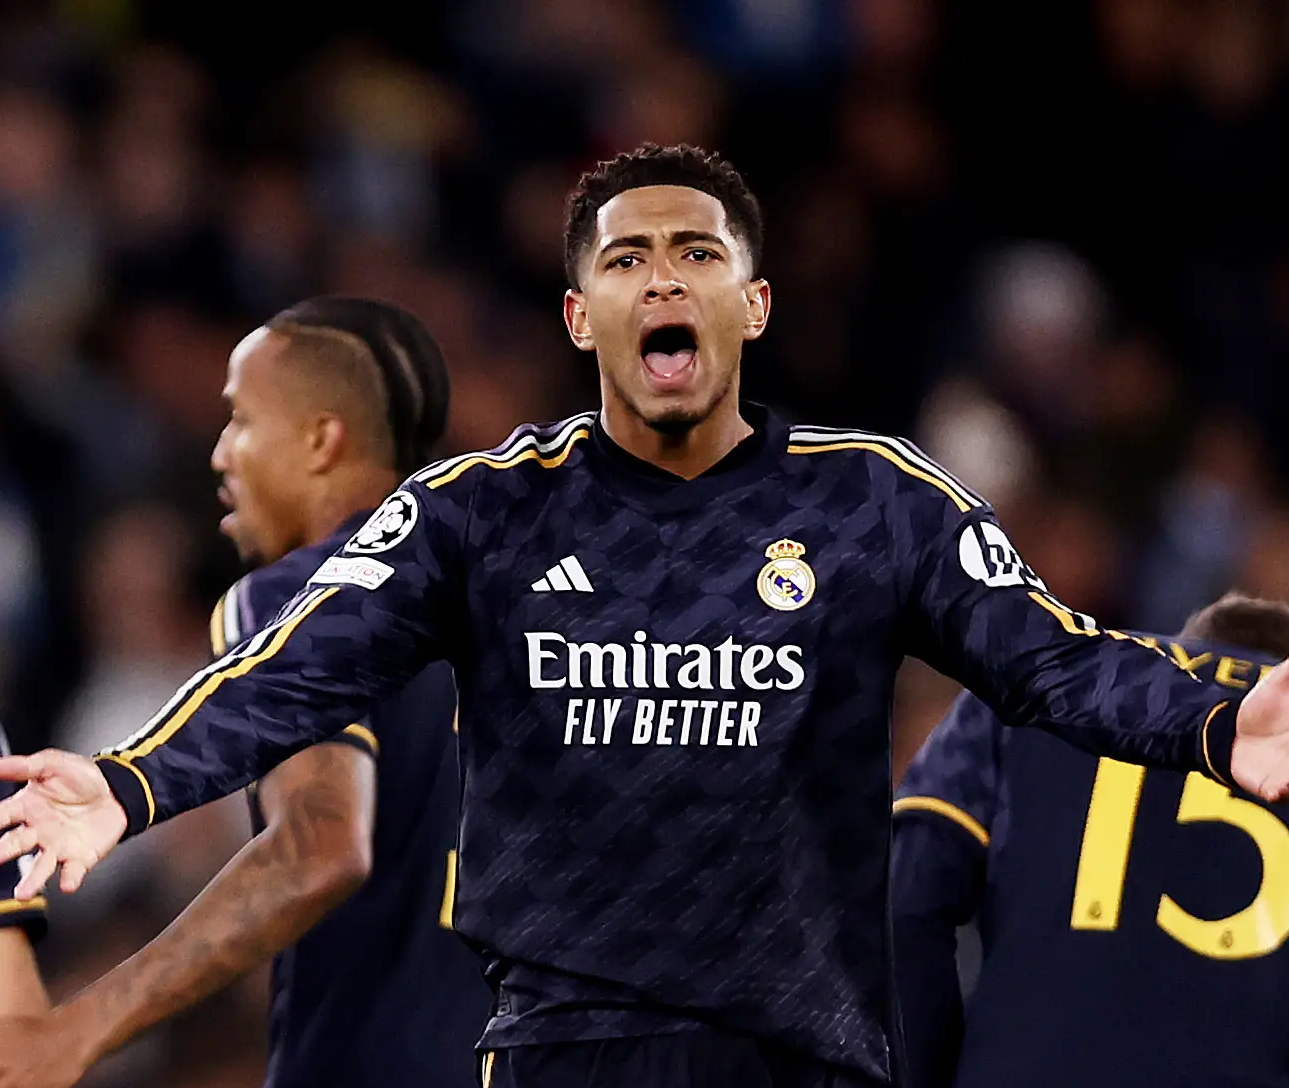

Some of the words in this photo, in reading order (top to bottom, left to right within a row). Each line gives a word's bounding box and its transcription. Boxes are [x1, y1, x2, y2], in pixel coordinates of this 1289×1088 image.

[523, 630, 805, 690] Emirates
[563, 698, 623, 745] FLY
[632, 698, 762, 747] BETTER
